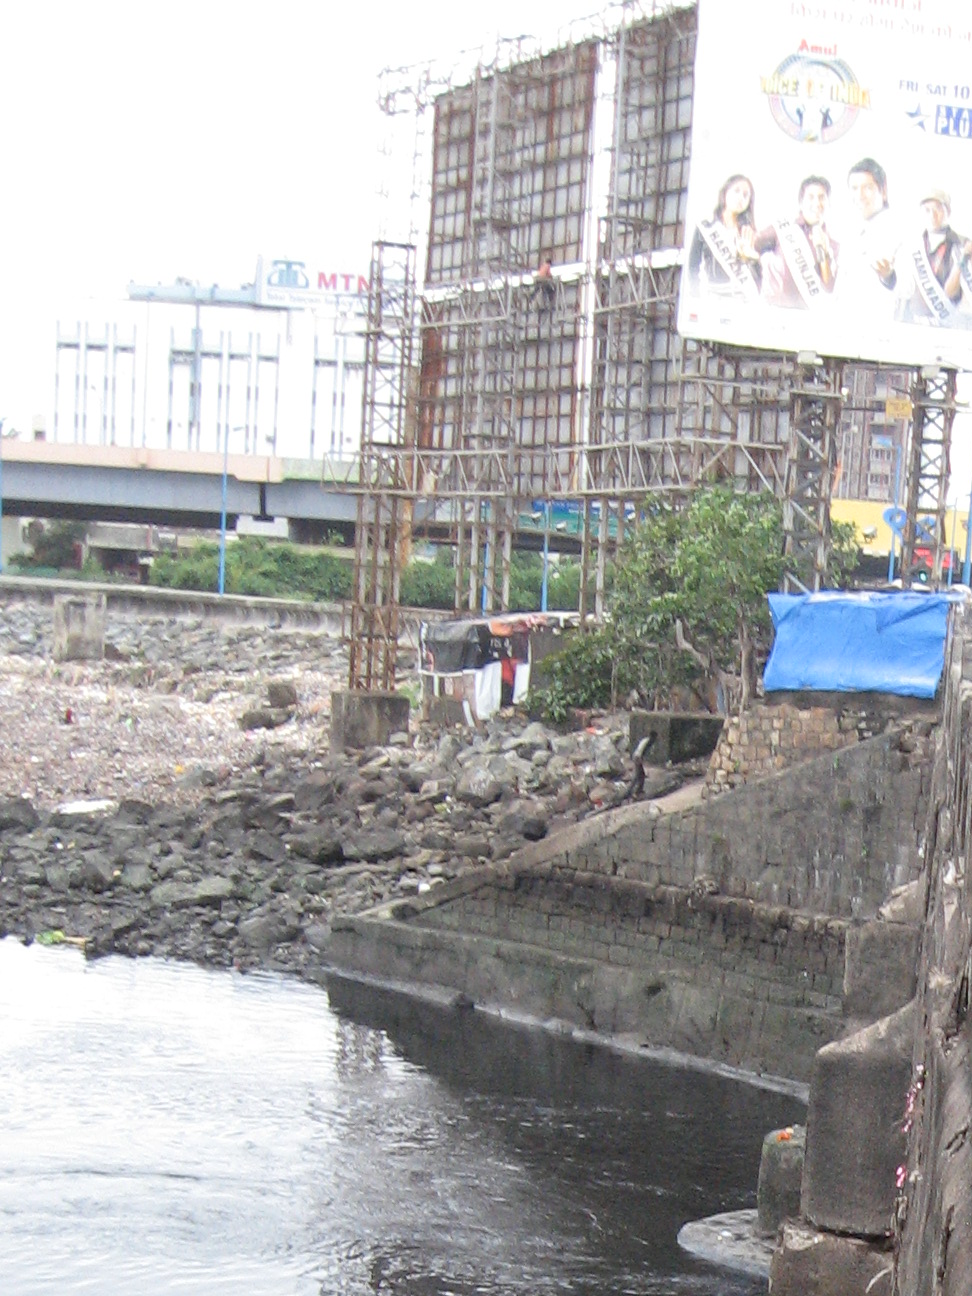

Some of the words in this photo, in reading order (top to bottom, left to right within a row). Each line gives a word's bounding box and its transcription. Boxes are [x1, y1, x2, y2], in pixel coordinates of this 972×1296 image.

[799, 38, 838, 57] Amul
[899, 79, 919, 92] FRI
[926, 83, 947, 97] SAT
[954, 84, 970, 100] 10
